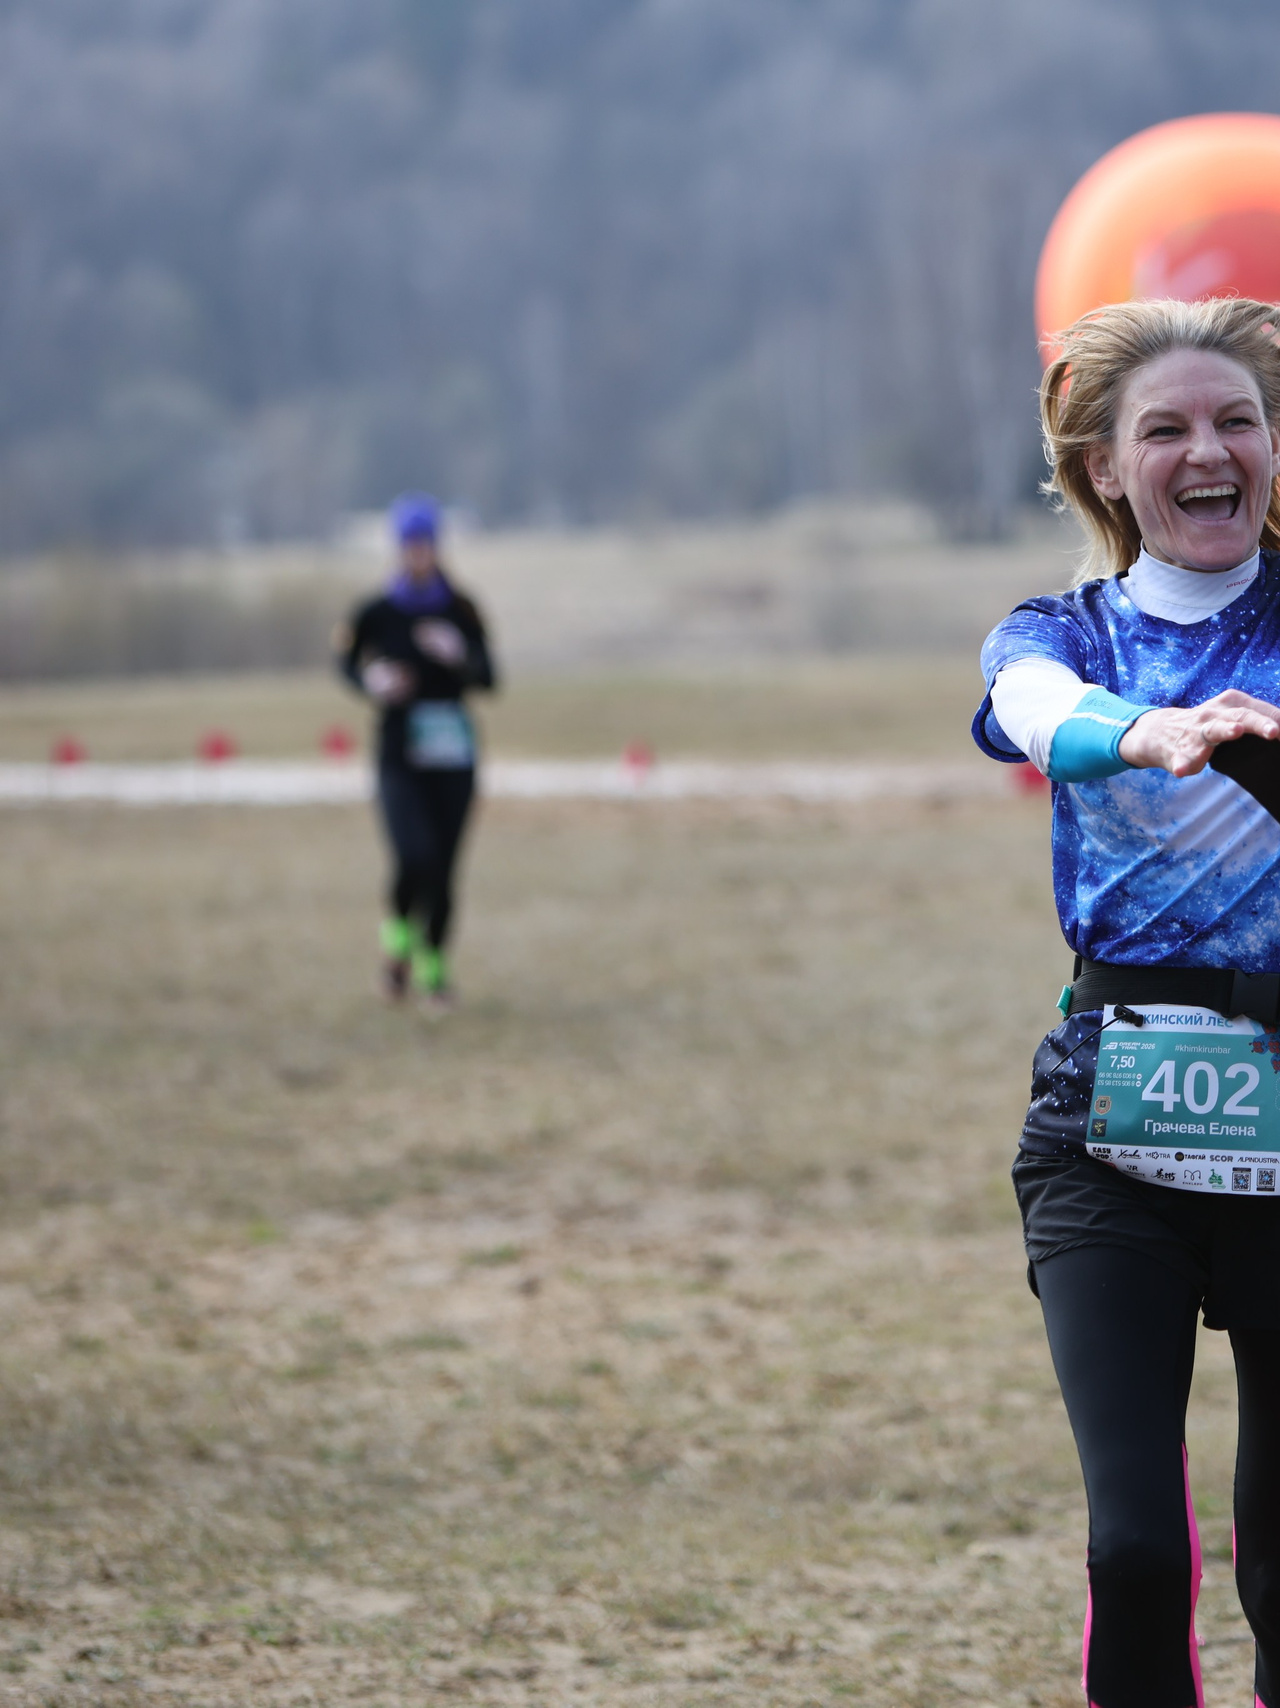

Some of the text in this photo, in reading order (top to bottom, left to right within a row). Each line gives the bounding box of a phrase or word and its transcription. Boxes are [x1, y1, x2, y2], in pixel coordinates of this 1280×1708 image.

[1117, 1012, 1234, 1028] КИНСКИЙ ЛЕС
[1174, 1044, 1231, 1054] #khimkirunbar
[1110, 1055, 1135, 1070] 7,50
[1141, 1060, 1260, 1116] 402
[1144, 1119, 1256, 1137] Грачева Елена
[1238, 1156, 1280, 1164] ALPINDUSTRIA
